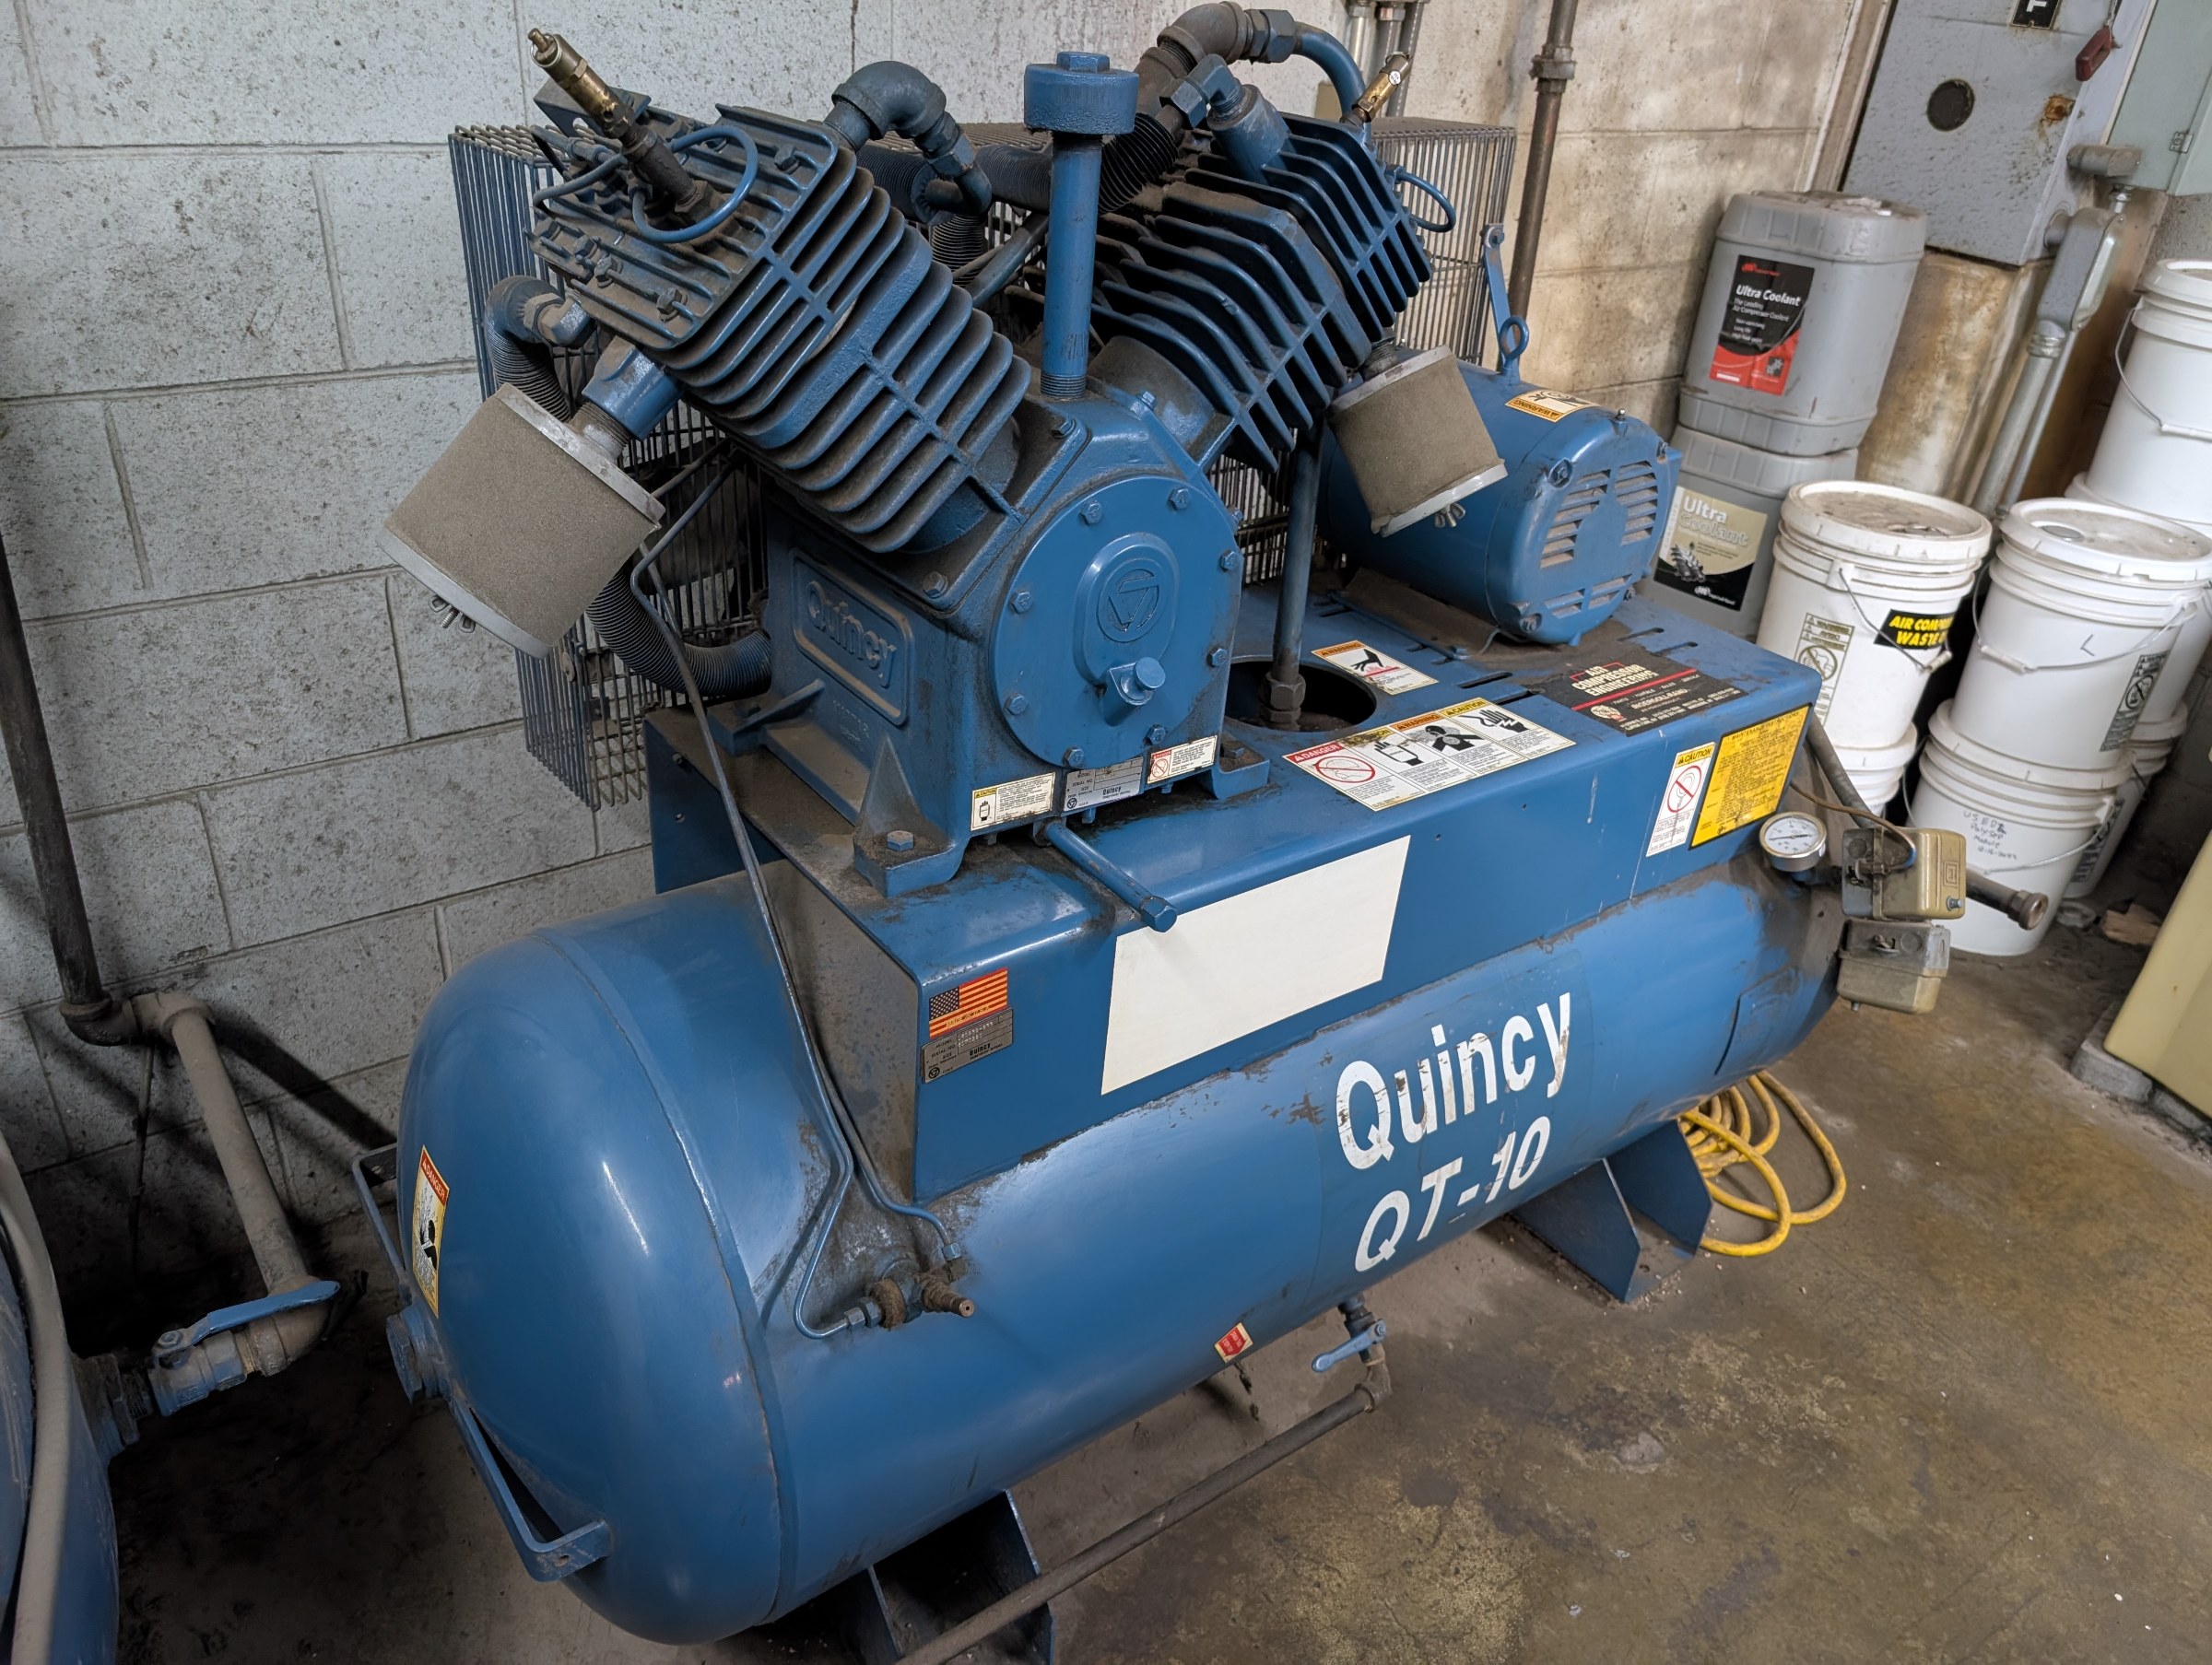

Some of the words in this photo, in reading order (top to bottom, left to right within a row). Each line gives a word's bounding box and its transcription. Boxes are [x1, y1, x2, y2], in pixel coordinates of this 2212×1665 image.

[1735, 284, 1761, 299] Ultra
[1762, 289, 1802, 306] Coolant
[1513, 399, 1550, 416] WARNING
[1683, 496, 1727, 523] Ultra
[1680, 512, 1748, 547] Coolant
[1889, 615, 1912, 630] AIR
[1571, 663, 1646, 691] COMPRESSOR
[1584, 665, 1608, 677] AIR
[1583, 669, 1659, 697] ENGINEERING
[1452, 699, 1487, 716] CAUTION
[1403, 713, 1441, 730] WARNING
[1303, 743, 1340, 760] DANGER
[1684, 747, 1712, 764] CAUTION
[1336, 992, 1571, 1170] Quincy
[426, 1164, 445, 1200] DANGER
[1354, 1115, 1551, 1272] QT-10
